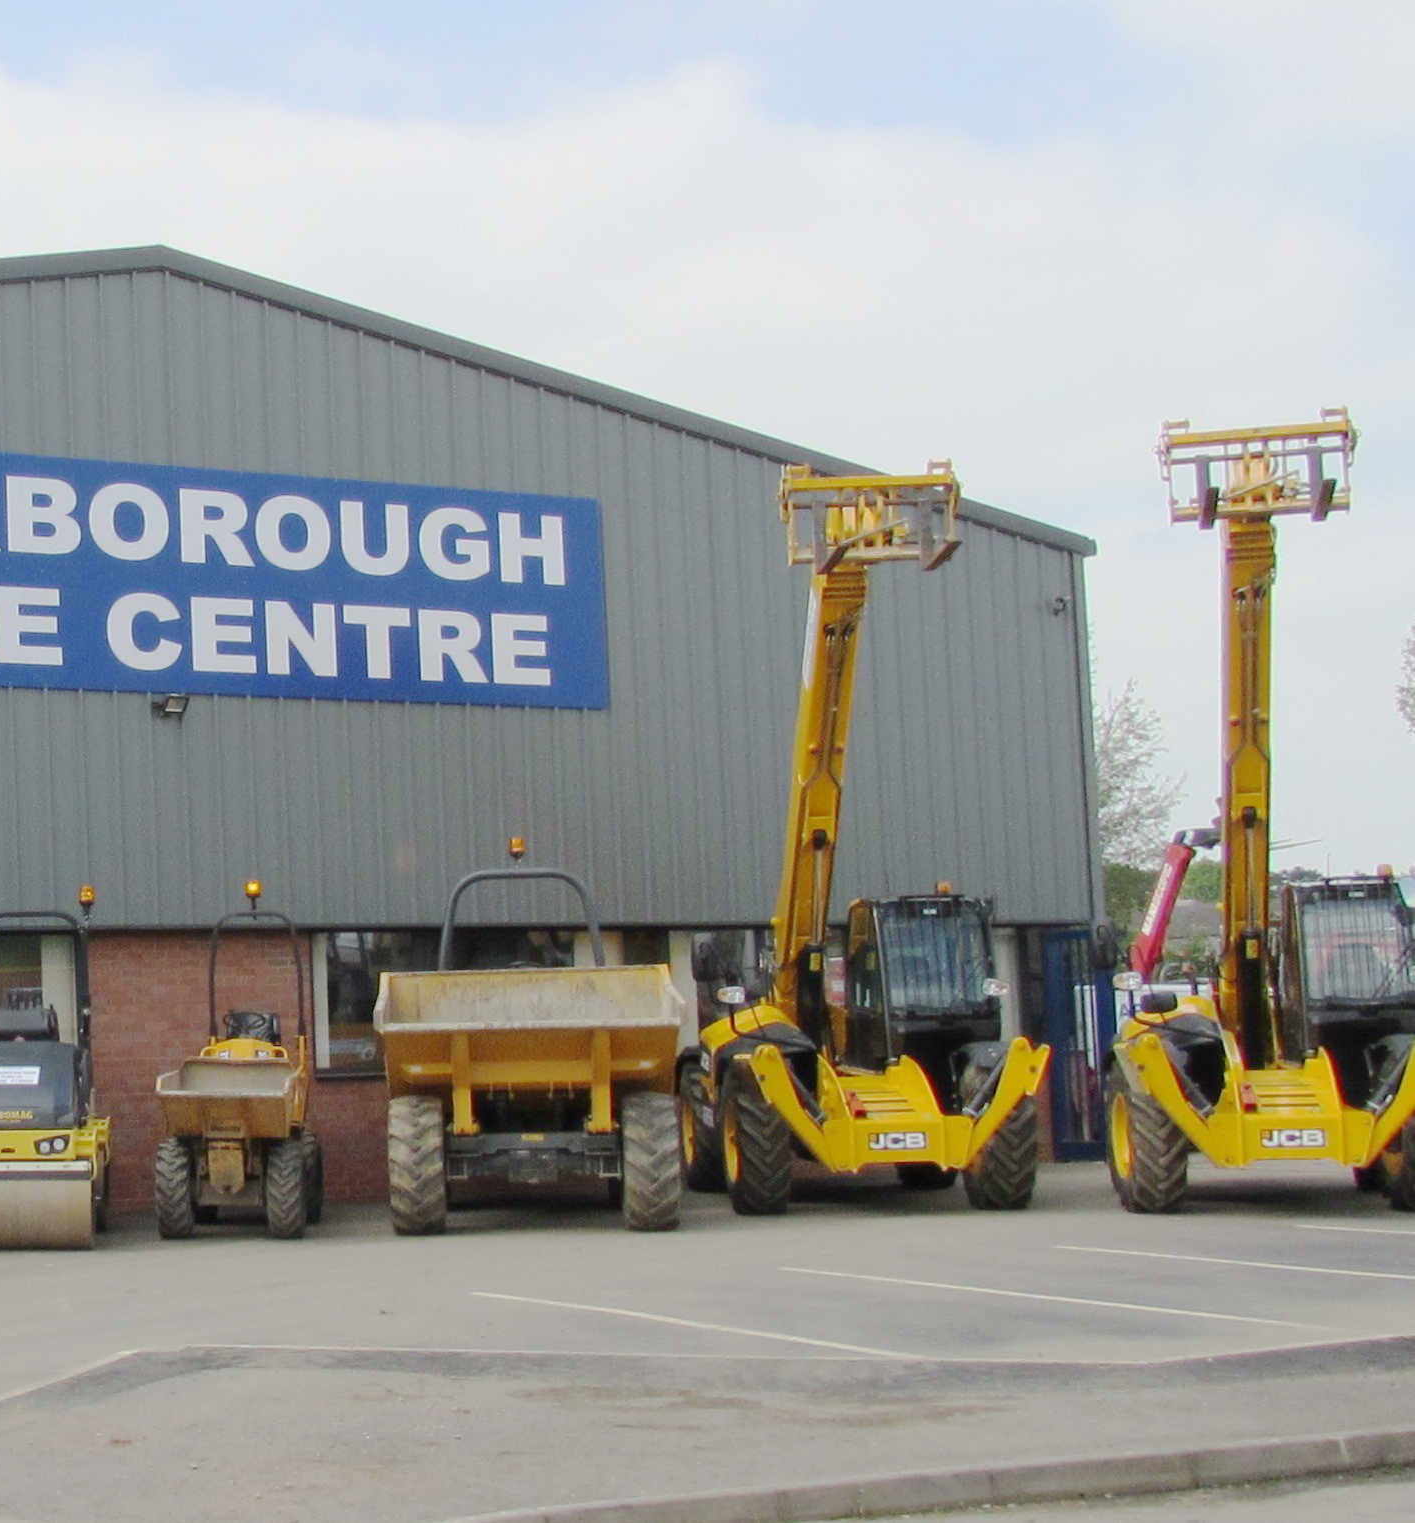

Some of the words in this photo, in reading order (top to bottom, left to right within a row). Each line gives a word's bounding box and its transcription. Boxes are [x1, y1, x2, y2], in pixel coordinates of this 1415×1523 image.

[106, 592, 552, 686] CENTRE
[869, 1132, 925, 1149] JCB
[1262, 1129, 1324, 1147] JCB
